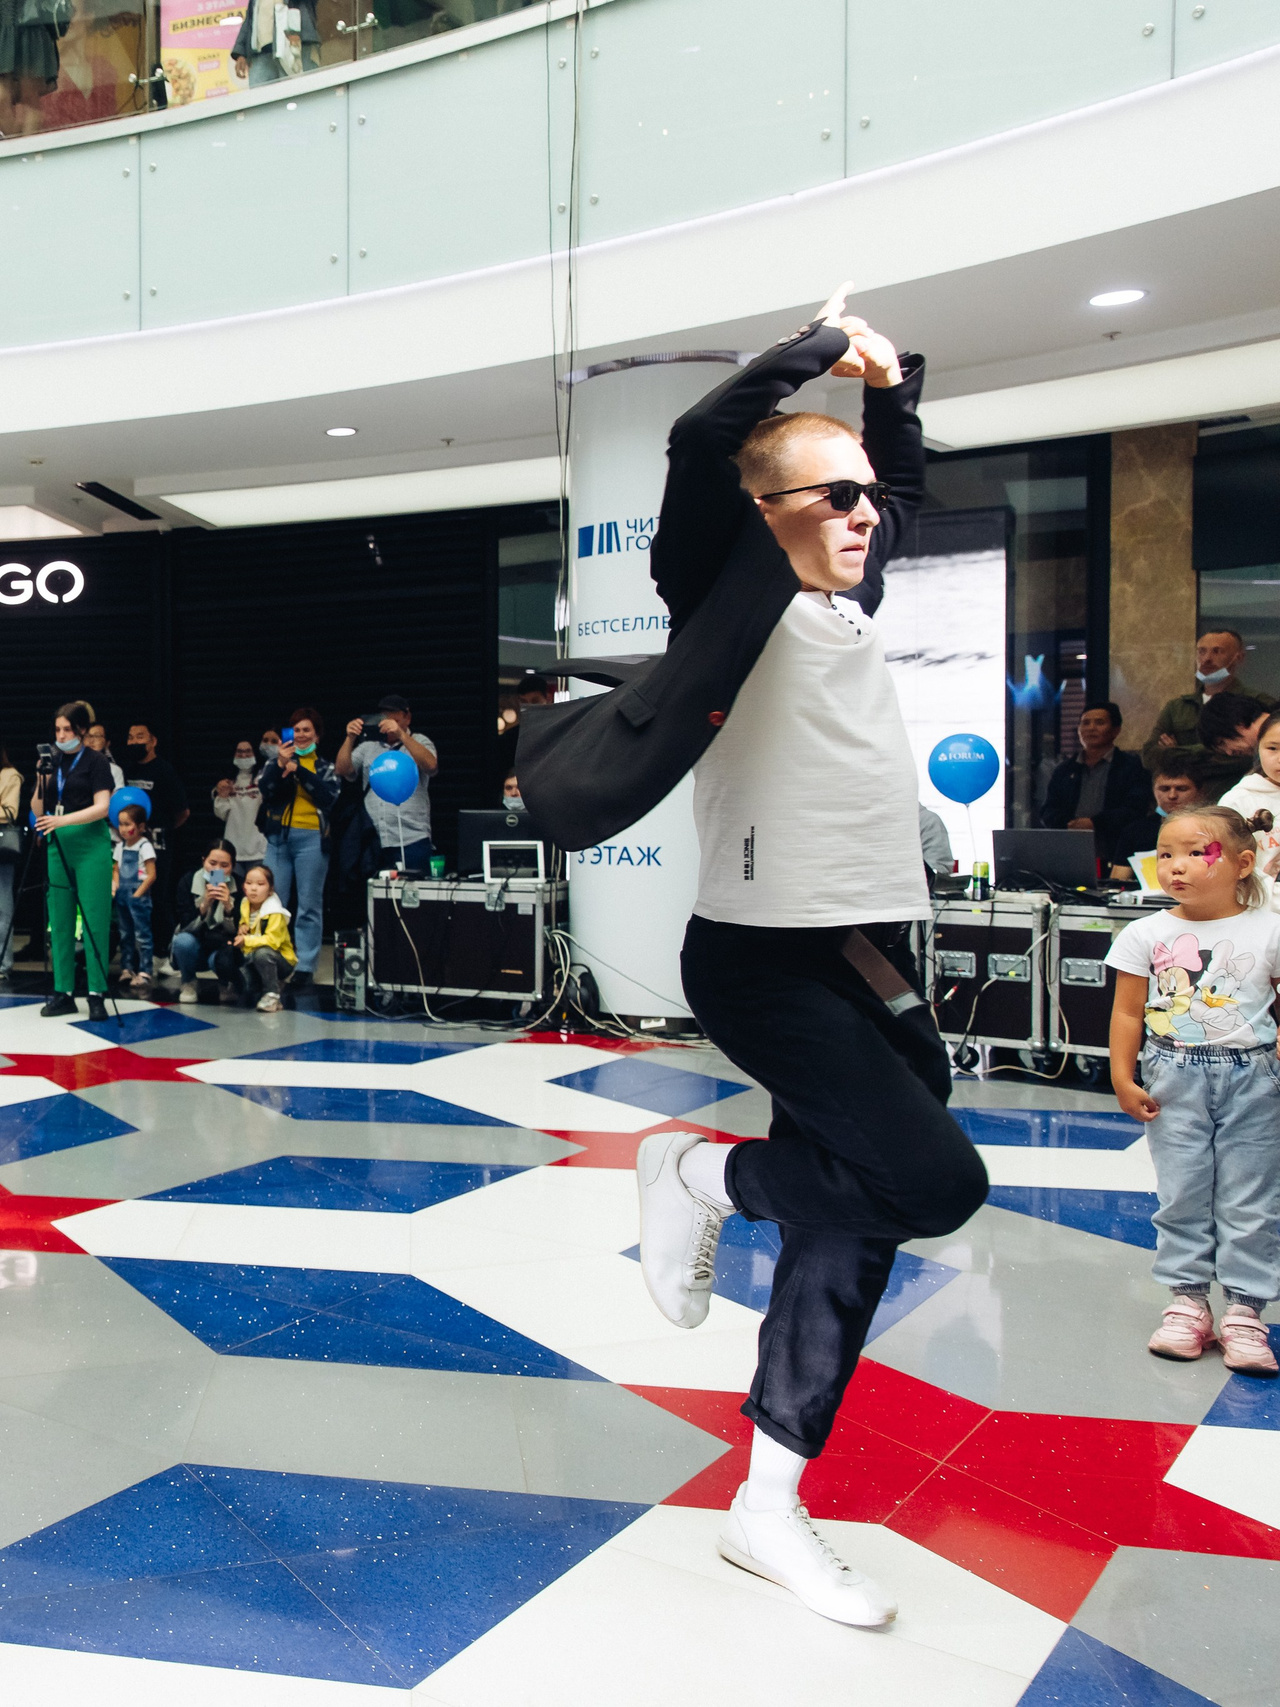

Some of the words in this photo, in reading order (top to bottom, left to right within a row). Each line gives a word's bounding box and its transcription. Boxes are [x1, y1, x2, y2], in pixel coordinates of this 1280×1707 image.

[171, 14, 222, 32] БИЗНЕС
[626, 535, 651, 551] ГО
[577, 615, 671, 637] БЕСТСЕЛЛЕ
[948, 752, 985, 761] FORUM
[590, 845, 662, 866] ЭТАЖ
